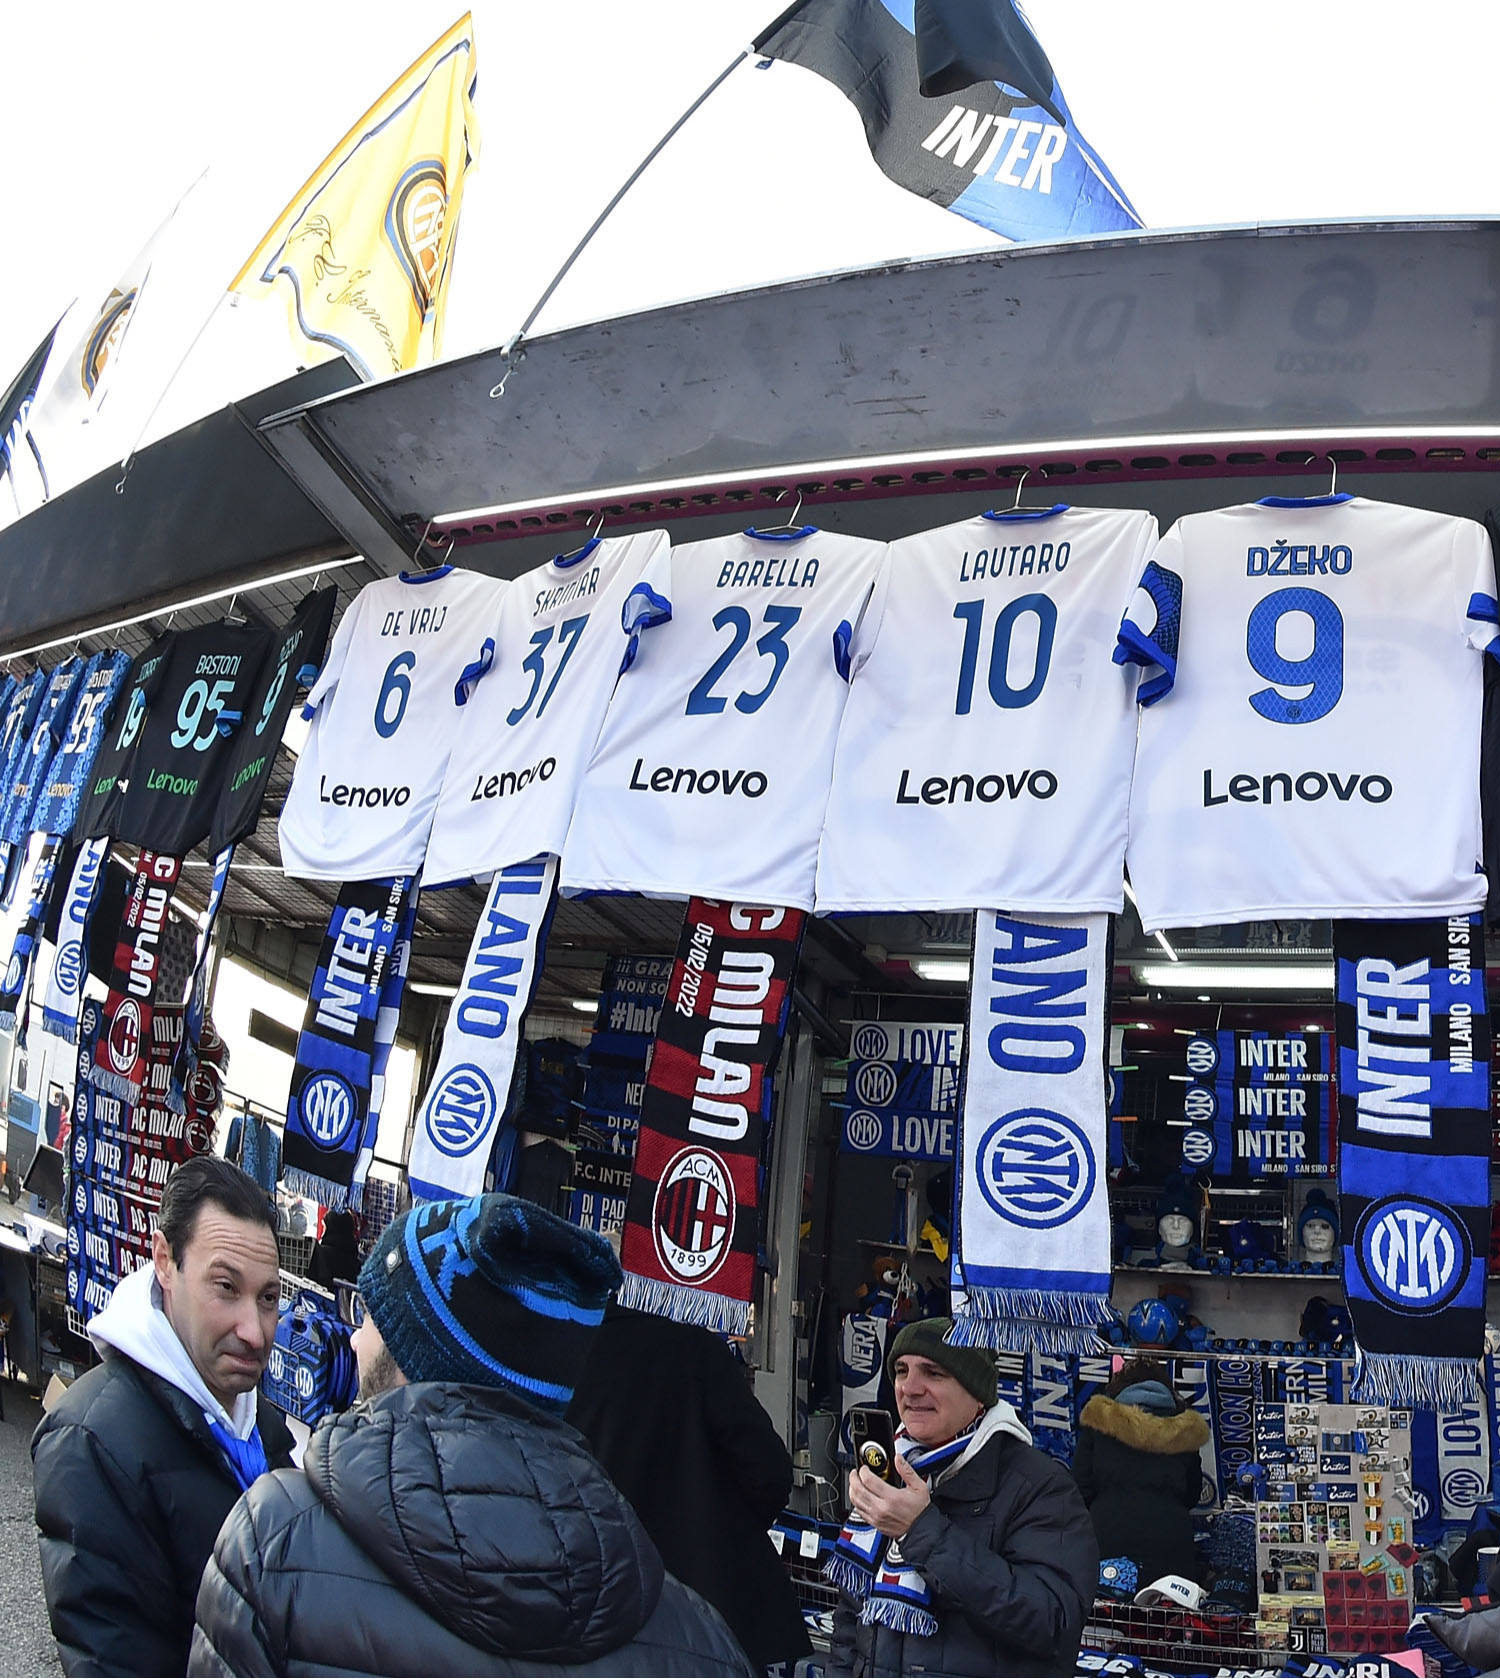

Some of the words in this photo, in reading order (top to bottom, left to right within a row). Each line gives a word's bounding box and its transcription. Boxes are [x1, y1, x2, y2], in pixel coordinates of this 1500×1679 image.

[921, 105, 1068, 195] INTER
[716, 558, 820, 588] BARELLA
[960, 542, 1072, 582] LAUTARO
[1246, 538, 1353, 577] DŽEKO
[381, 610, 404, 636] DE
[409, 606, 448, 635] VRIJ
[195, 655, 241, 676] BASTONI
[506, 613, 591, 726] 37
[684, 605, 803, 716] 23
[952, 592, 1058, 716] 10
[1246, 586, 1344, 725] 9
[256, 662, 288, 736] 9
[374, 651, 416, 738] 6
[63, 692, 107, 754] 95
[171, 679, 236, 751] 95
[147, 768, 198, 796] Lenovo
[320, 775, 411, 808] Lenovo
[471, 757, 556, 802] Lenovo
[629, 758, 768, 798] Lenovo
[896, 769, 1058, 806] Lenovo
[1203, 769, 1393, 807] Lenovo
[127, 872, 148, 929] 05/02/2022
[127, 887, 168, 998] MILAN
[369, 945, 388, 995] MILANO
[382, 905, 401, 933] SAN
[314, 906, 379, 1036] INTER
[676, 923, 713, 1018] 05/02/2022
[1448, 947, 1472, 986] SAN
[616, 980, 646, 994] NON
[688, 950, 776, 1141] MILAN
[899, 1028, 956, 1063] LOVE
[1239, 1038, 1308, 1068] INTER
[1356, 957, 1433, 1139] INTER
[1449, 1002, 1474, 1074] MILANO
[1263, 1072, 1290, 1081] MILANO
[1296, 1073, 1311, 1082] SAN
[1312, 1073, 1329, 1082] SIRO
[94, 1094, 121, 1126] INTER
[131, 1106, 147, 1132] AC
[148, 1108, 186, 1139] MILAN
[1238, 1087, 1307, 1117] INTER
[608, 1116, 620, 1129] DI
[891, 1116, 954, 1156] LOVE
[94, 1138, 121, 1172] INTER
[130, 1152, 148, 1179] AC
[1237, 1129, 1306, 1159] INTER
[574, 1162, 596, 1181] F.C.
[679, 1156, 720, 1188] ACM
[1261, 1163, 1288, 1173] MILANO
[1294, 1164, 1310, 1173] SAN
[1311, 1164, 1328, 1174] SIRO
[93, 1189, 119, 1225] INTER
[130, 1206, 147, 1233] AC
[581, 1193, 594, 1214] DI
[85, 1230, 110, 1266] INTER
[670, 1247, 708, 1268] 1899
[1218, 1392, 1252, 1443] NON
[1170, 1582, 1191, 1598] INTER
